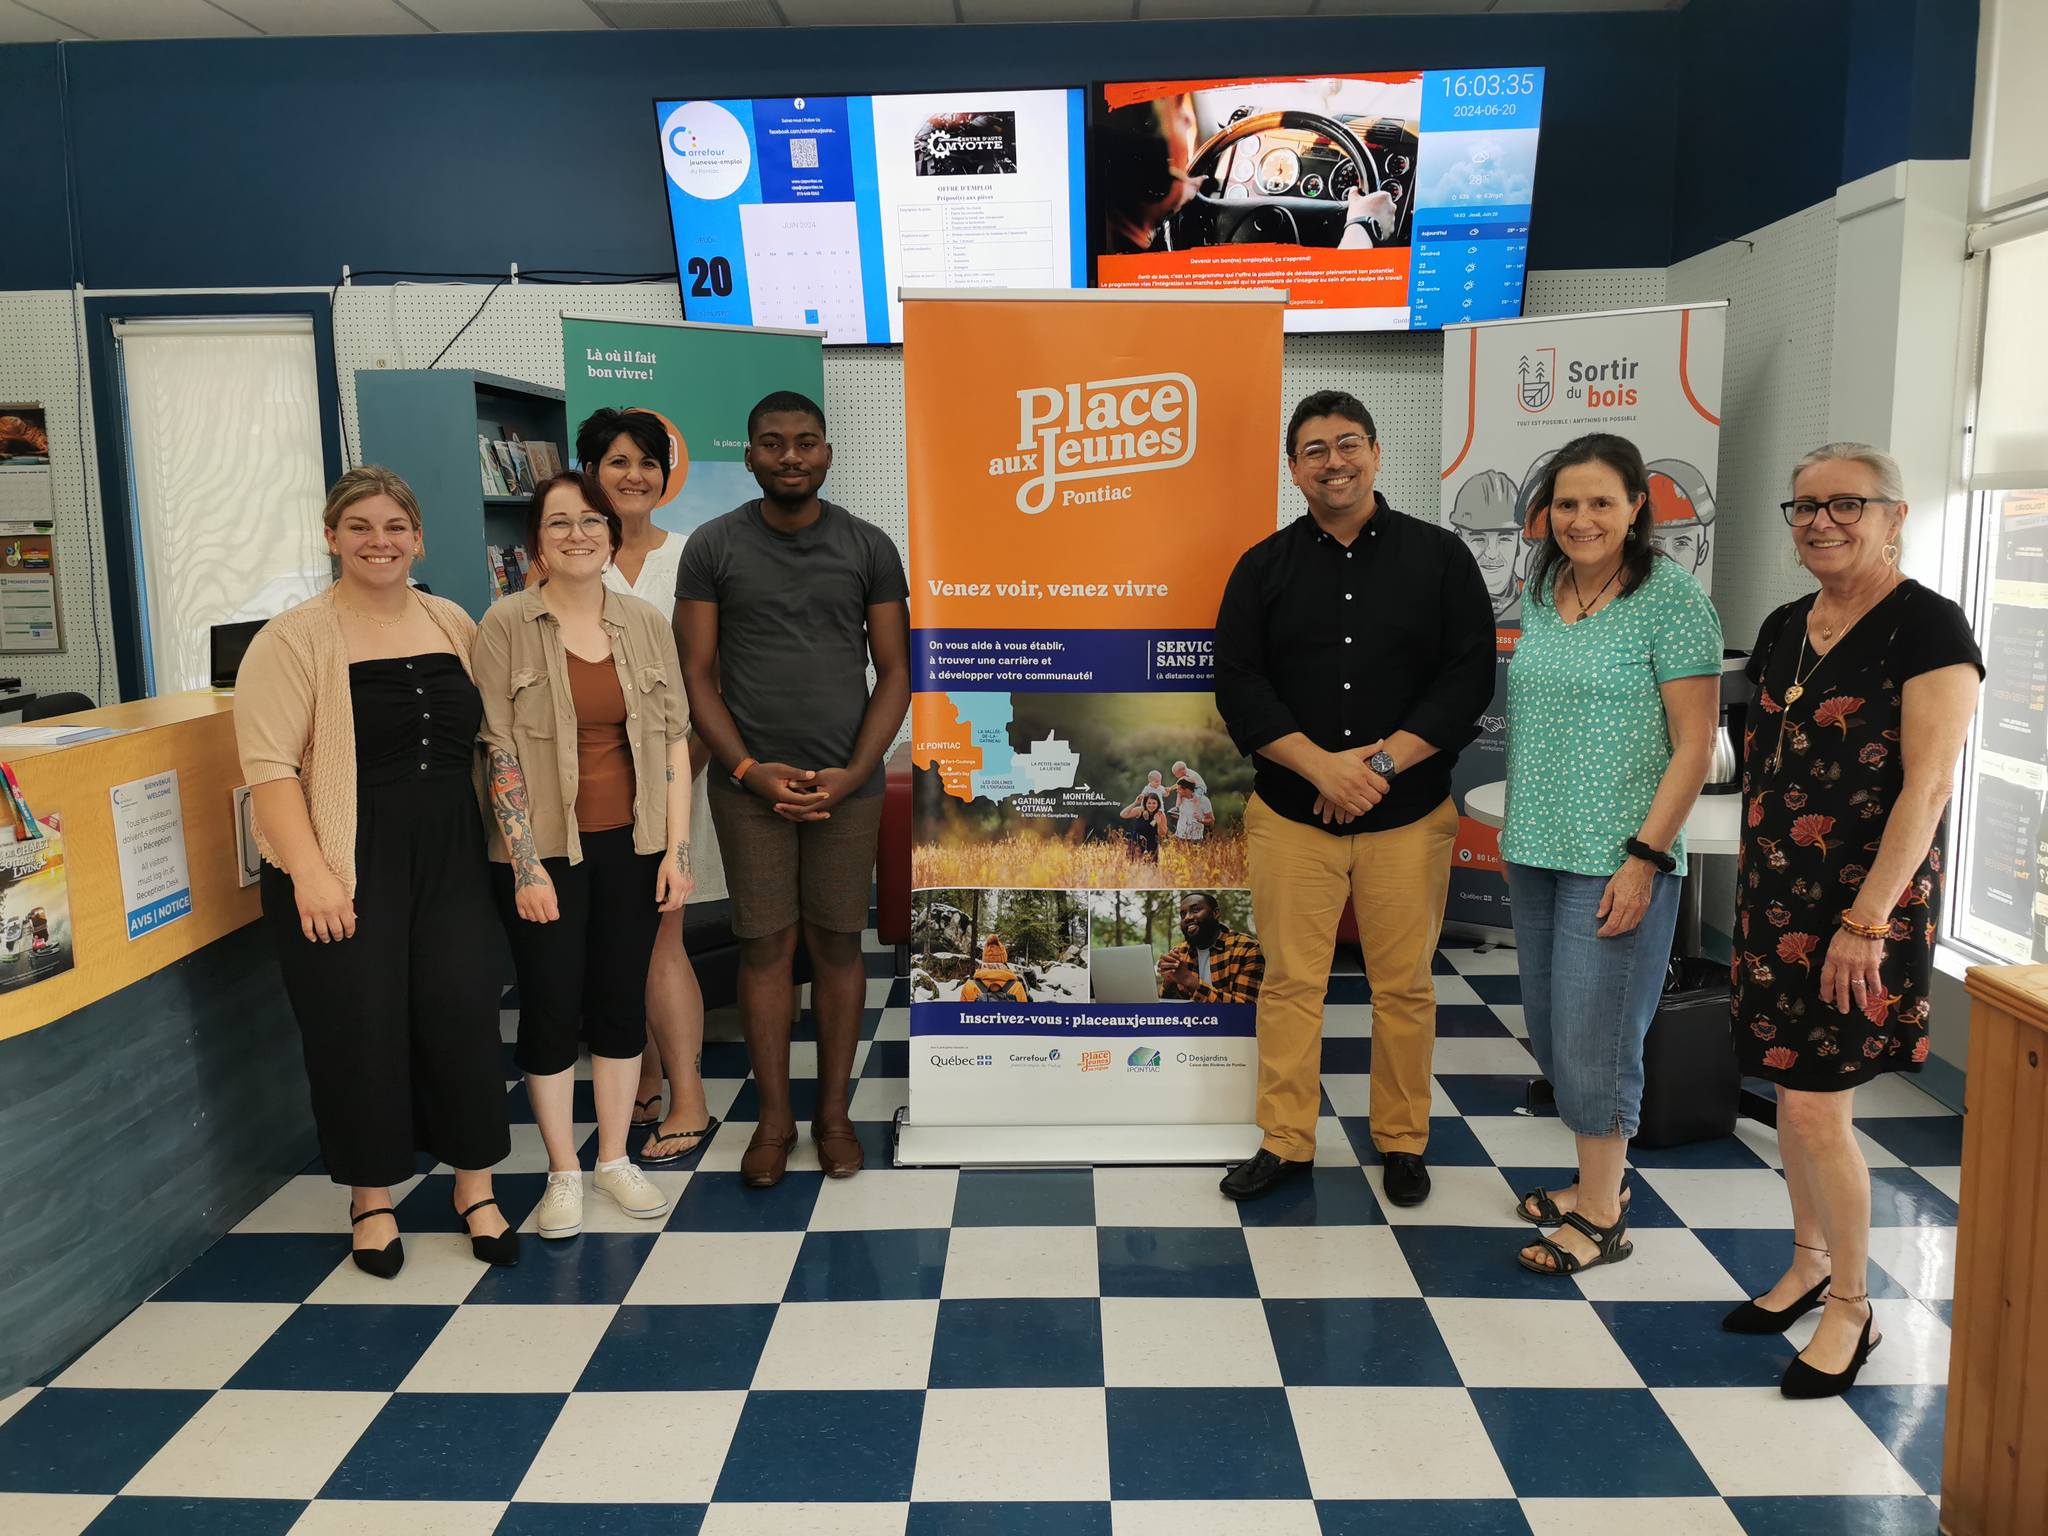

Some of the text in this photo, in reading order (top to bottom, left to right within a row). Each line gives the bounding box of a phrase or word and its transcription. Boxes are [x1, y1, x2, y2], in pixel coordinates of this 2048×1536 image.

[1442, 73, 1534, 97] 16:03:35
[1453, 104, 1517, 117] 2024-06-20
[937, 140, 1003, 152] AMYOTTE
[687, 255, 733, 298] 20
[586, 348, 657, 364] Là où il fait
[588, 365, 612, 378] bon
[1568, 357, 1639, 383] Sortir
[1566, 383, 1638, 408] du bois
[1016, 383, 1184, 451] Place
[721, 440, 742, 448] place
[988, 452, 1038, 476] aux
[1062, 485, 1133, 507] Pontiac
[928, 579, 1169, 600] Venez voir, venez vivre
[929, 639, 1066, 652] On vous aide à vous établir,
[929, 655, 1052, 666] à trouver une carrière et
[1156, 655, 1196, 668] SANS
[929, 669, 1093, 682] à développer votre communauté!
[1156, 672, 1164, 681] (à
[1165, 671, 1196, 681] distance
[916, 742, 961, 751] LE PONTIAC
[144, 777, 171, 791] BIENVENUE
[147, 787, 172, 801] WELCOME
[1062, 791, 1106, 801] MONTRÉAL
[1017, 797, 1057, 806] GATINEAU
[1021, 805, 1054, 813] OTTAWA
[126, 808, 173, 829] Tous les visiteurs
[143, 834, 172, 852] Réception
[141, 856, 169, 870] All visitors
[138, 876, 153, 886] must
[153, 872, 162, 881] log
[163, 868, 169, 876] in
[136, 879, 179, 900] Reception Desk
[131, 895, 190, 932] AVIS NOTICE
[959, 1012, 1063, 1025] Inscrivez-vous
[1072, 1013, 1219, 1028] placeauxjeunes.qc.ca
[930, 1055, 975, 1067] Québec
[1009, 1054, 1048, 1062] Carrefour
[1081, 1051, 1109, 1062] Place
[1189, 1054, 1228, 1063] Desjardins
